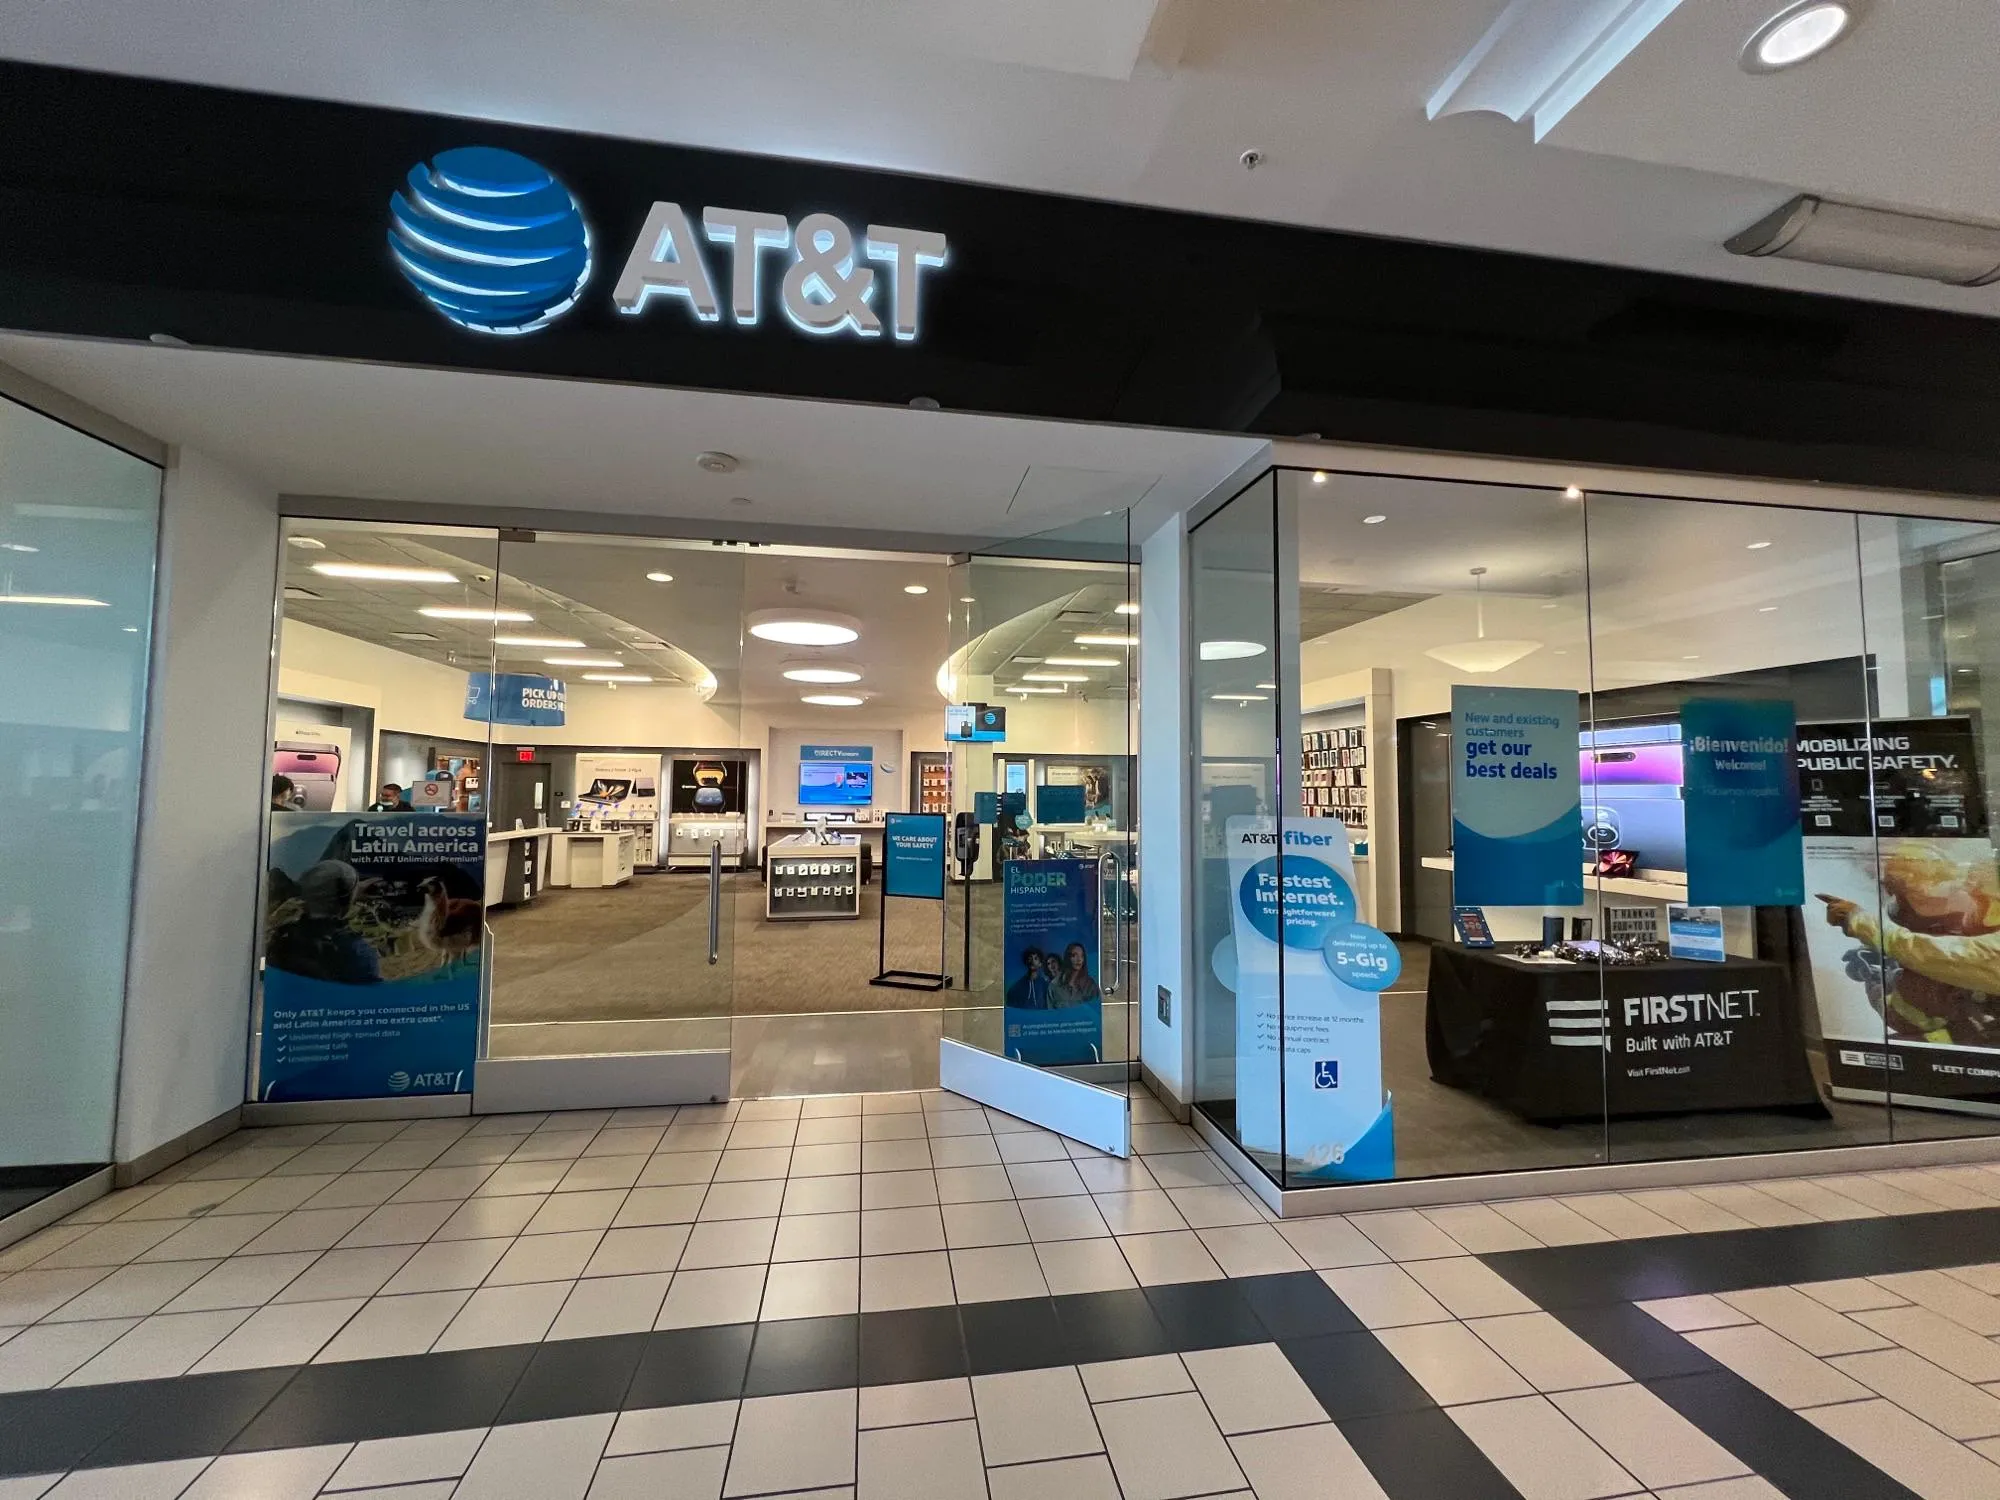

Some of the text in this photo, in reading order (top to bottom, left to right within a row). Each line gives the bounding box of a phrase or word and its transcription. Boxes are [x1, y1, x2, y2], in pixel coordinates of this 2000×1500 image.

[613, 200, 948, 340] AT&T
[522, 687, 545, 699] PICK
[521, 699, 557, 710] ORDERS
[1464, 712, 1560, 729] New and existing
[1465, 726, 1525, 738] customers
[1466, 740, 1532, 759] get our
[1690, 736, 1789, 753] ¡Bienvenido!
[1466, 760, 1557, 779] best deals
[1714, 759, 1766, 771] Welcome!
[1871, 754, 1958, 770] SAFETY.
[354, 822, 477, 837] Travel across
[351, 838, 479, 853] Latin America
[1241, 830, 1333, 846] AT&T fiber
[351, 855, 371, 863] with
[397, 855, 439, 863] Unlimited
[1010, 866, 1020, 874] EL
[1010, 872, 1067, 887] PODER
[1258, 872, 1332, 889] Fastest
[1010, 886, 1048, 895] HISPANO
[1262, 907, 1336, 918] Strightforward
[1336, 951, 1388, 972] 5-Gig
[273, 1003, 470, 1019] Only AT&T keeps you connected in the US
[1266, 1012, 1276, 1020] No
[273, 1021, 292, 1030] and
[294, 1020, 319, 1029] Latin
[321, 1018, 361, 1028] America
[363, 1018, 373, 1026] at
[1626, 1030, 1734, 1053] Built with AT&T
[1931, 1063, 1964, 1075] FLEET
[413, 1071, 455, 1087] AT&T
